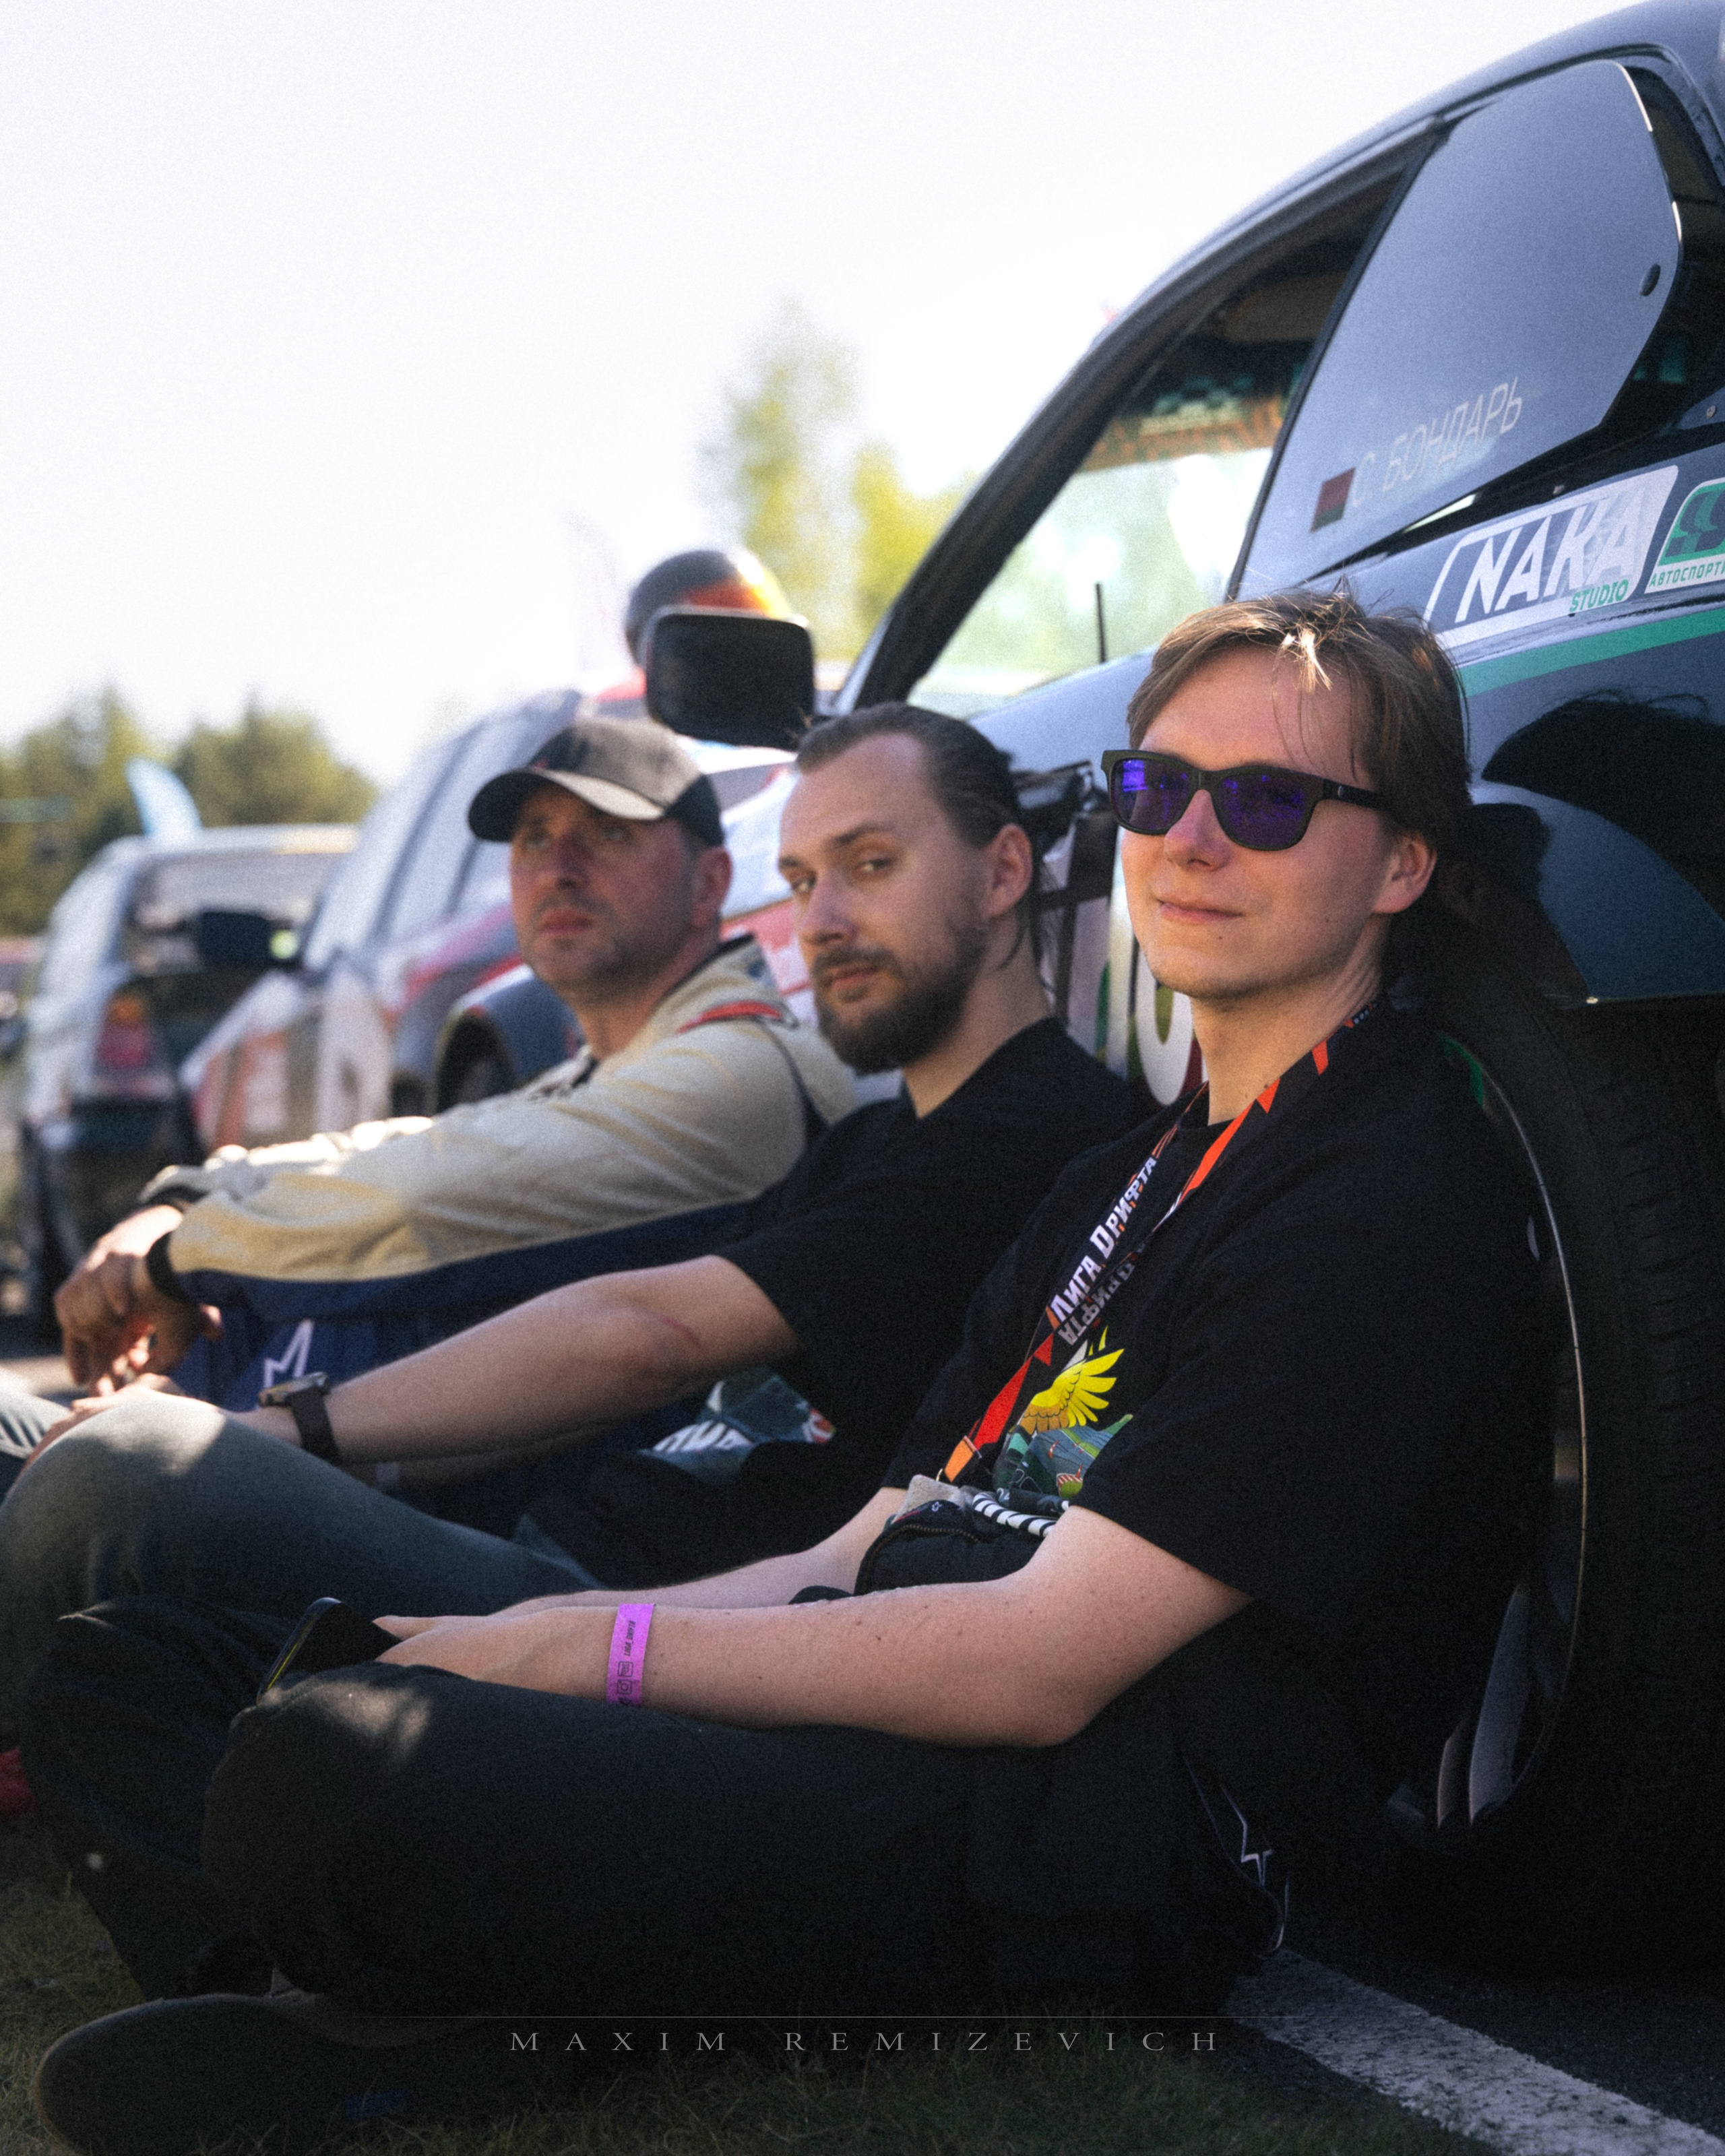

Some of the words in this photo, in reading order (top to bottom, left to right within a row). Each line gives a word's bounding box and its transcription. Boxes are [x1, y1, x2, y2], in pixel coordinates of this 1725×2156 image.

[1383, 376, 1523, 493] БОНДАРЬ
[1454, 486, 1645, 624] NAKA
[1569, 579, 1629, 612] STUDIO
